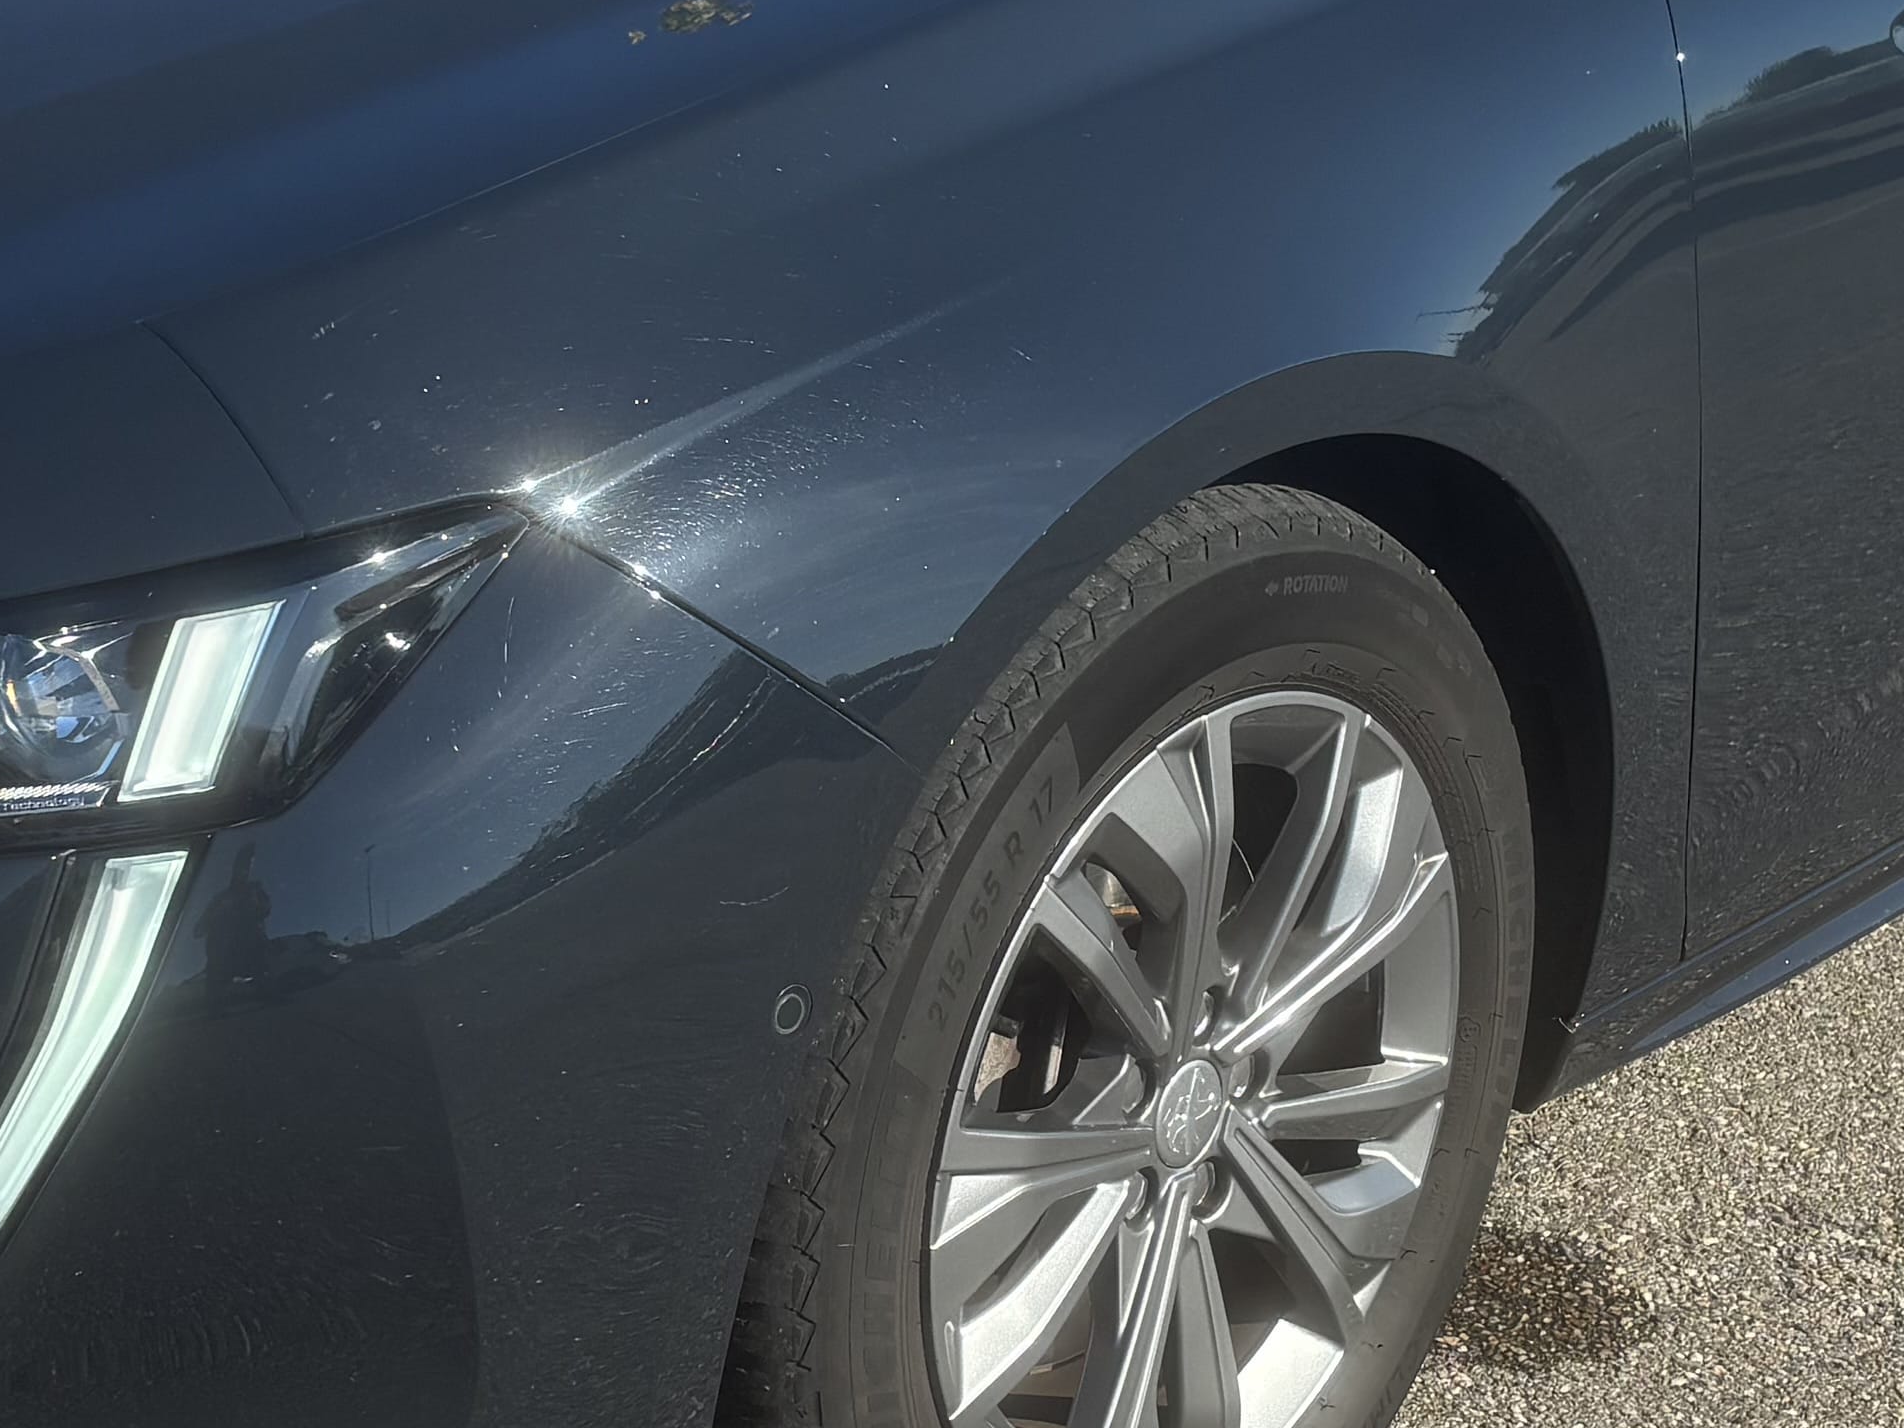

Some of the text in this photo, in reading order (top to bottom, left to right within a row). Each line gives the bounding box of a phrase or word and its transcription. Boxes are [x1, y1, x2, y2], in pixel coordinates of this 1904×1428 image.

[1283, 574, 1348, 596] ROTATION
[928, 775, 1053, 1030] 215/55 R 17
